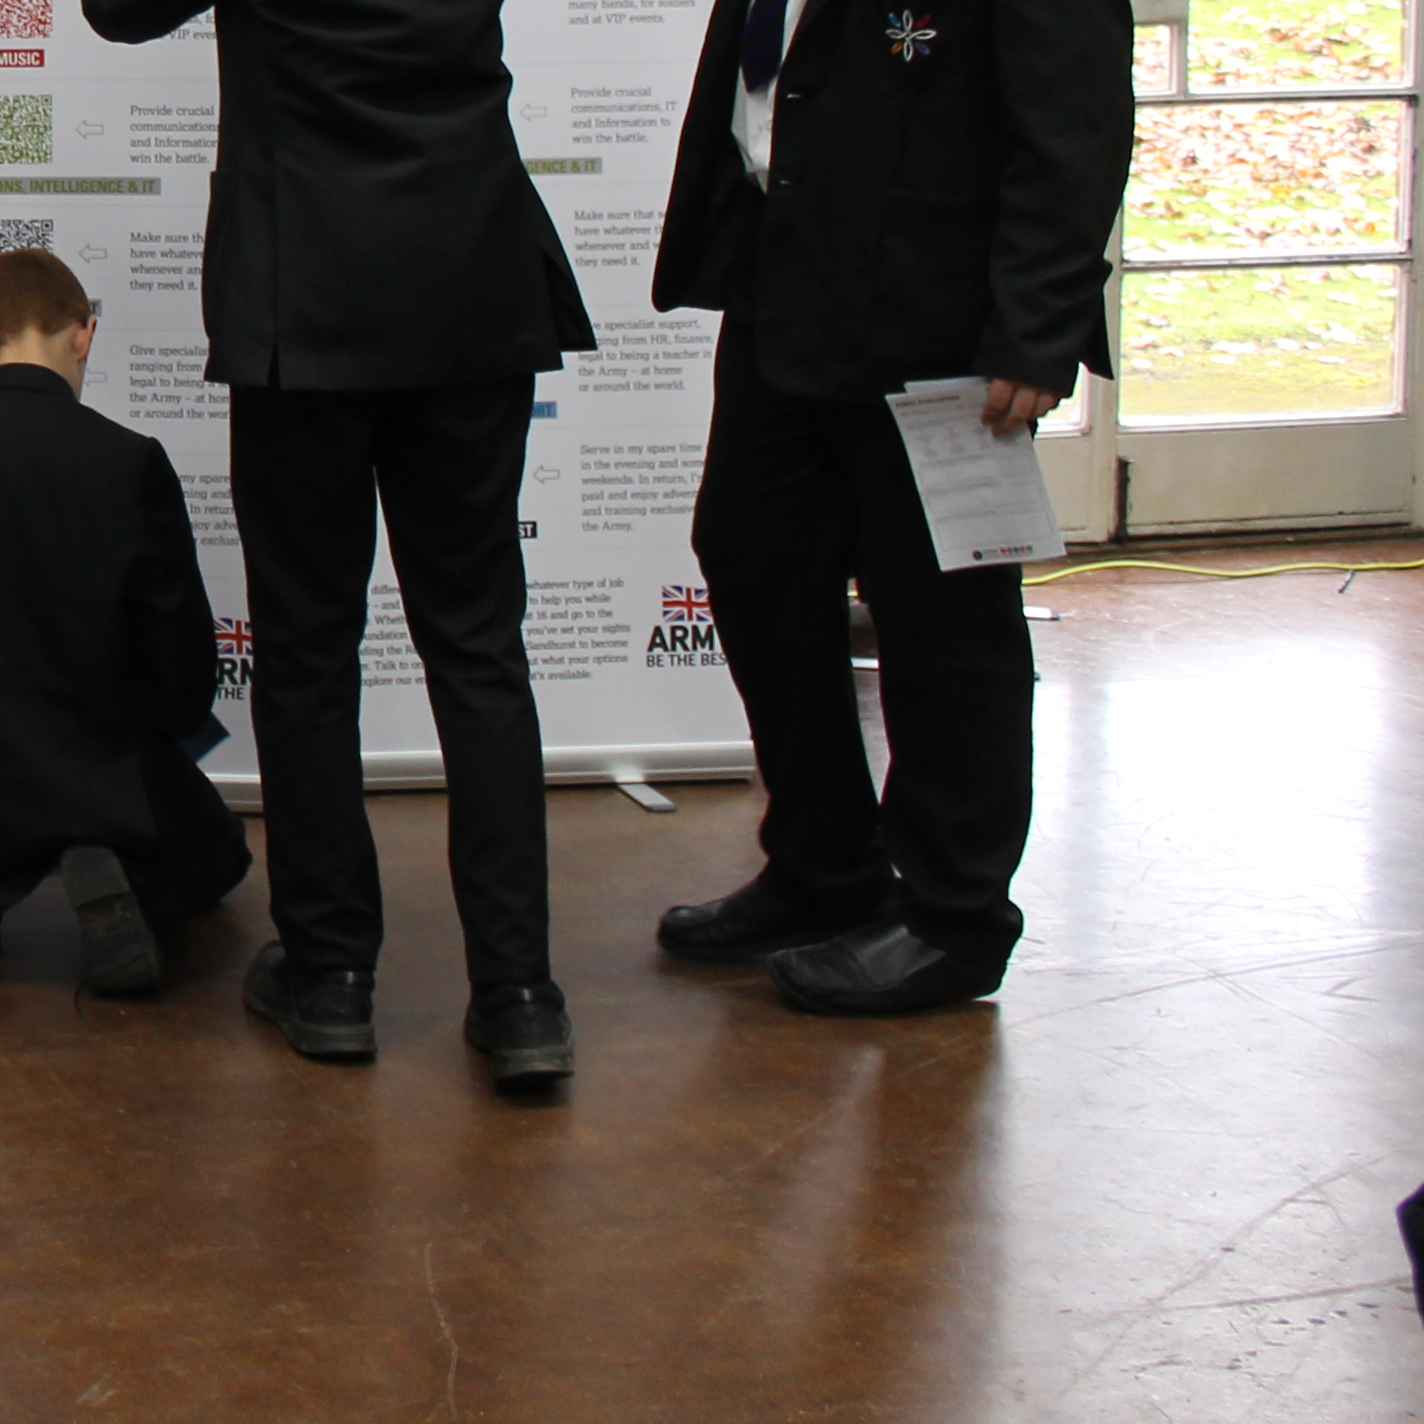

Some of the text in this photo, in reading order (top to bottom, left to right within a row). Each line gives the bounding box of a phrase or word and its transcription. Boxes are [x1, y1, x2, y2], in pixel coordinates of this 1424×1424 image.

[130, 103, 214, 116] Provide crucial
[129, 153, 151, 163] win
[154, 151, 172, 163] the
[30, 178, 124, 193] INTELLIGENCE
[127, 179, 138, 193] &
[142, 179, 155, 193] IT
[129, 278, 154, 293] they
[157, 278, 184, 290] need
[129, 359, 203, 375] ranging from
[129, 375, 204, 390] legal to being
[130, 390, 204, 406] the Army at
[647, 625, 715, 652] ARM
[647, 653, 727, 667] BE THE BES
